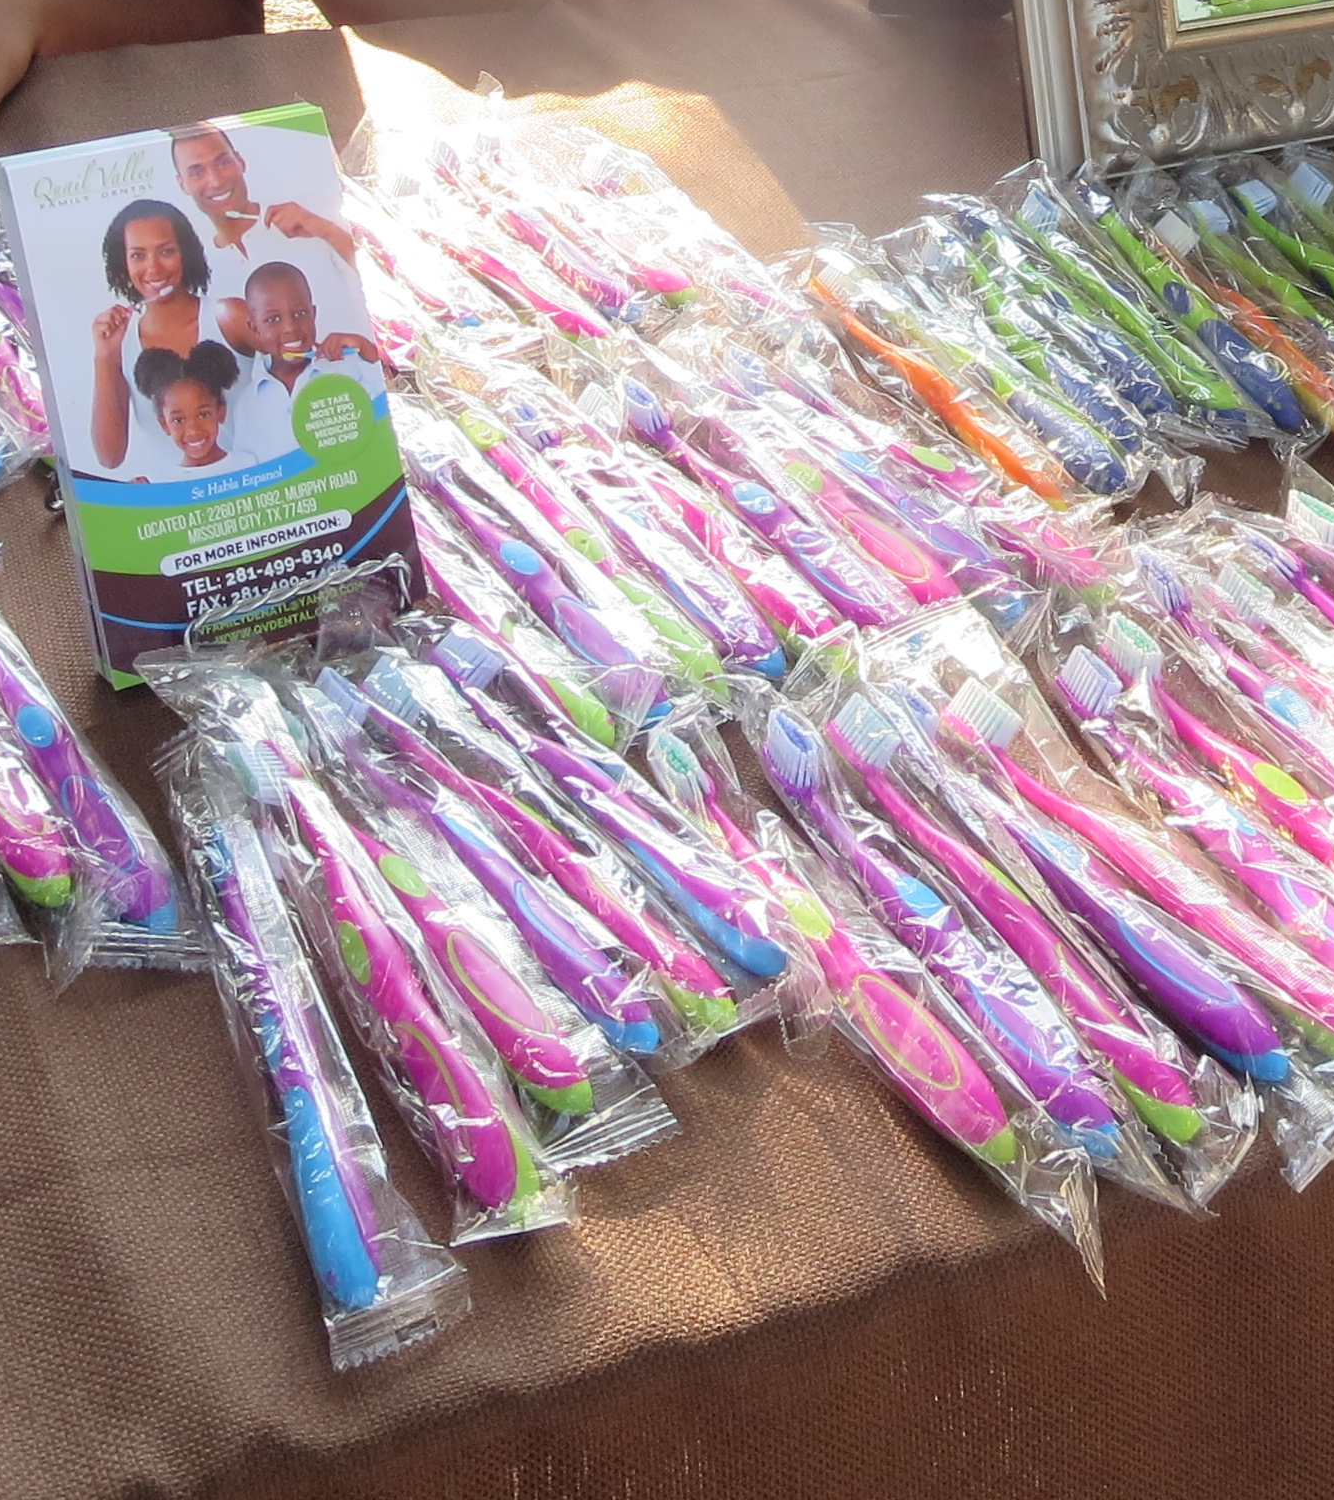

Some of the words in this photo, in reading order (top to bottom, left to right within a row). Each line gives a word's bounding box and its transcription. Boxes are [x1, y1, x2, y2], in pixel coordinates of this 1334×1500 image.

[33, 159, 97, 204] Quail
[40, 196, 89, 209] FAMILY
[101, 183, 154, 198] DENTAL
[310, 399, 326, 409] WE
[327, 393, 351, 405] TAKE
[310, 407, 335, 419] MOST
[337, 402, 355, 413] PPO
[314, 421, 358, 439] MEDICAID
[318, 437, 337, 448] AND
[338, 430, 359, 442] CHIP
[138, 516, 187, 541] LOCATED
[188, 511, 207, 532] AT:
[207, 504, 236, 527] 2260
[236, 498, 253, 518] FM
[284, 479, 327, 503] MURPHY
[328, 469, 359, 492] ROAD
[191, 486, 205, 500] Se
[187, 519, 238, 545] MISSOURI
[239, 511, 267, 533] CITY,
[267, 506, 282, 526] TX
[282, 497, 318, 521] 77459
[174, 552, 203, 571] FOR
[204, 541, 245, 564] MORE
[246, 515, 342, 556] INFORMATION:
[181, 576, 222, 598] TEL:
[224, 542, 344, 587] 281-499-8340
[185, 596, 228, 619] FAX:
